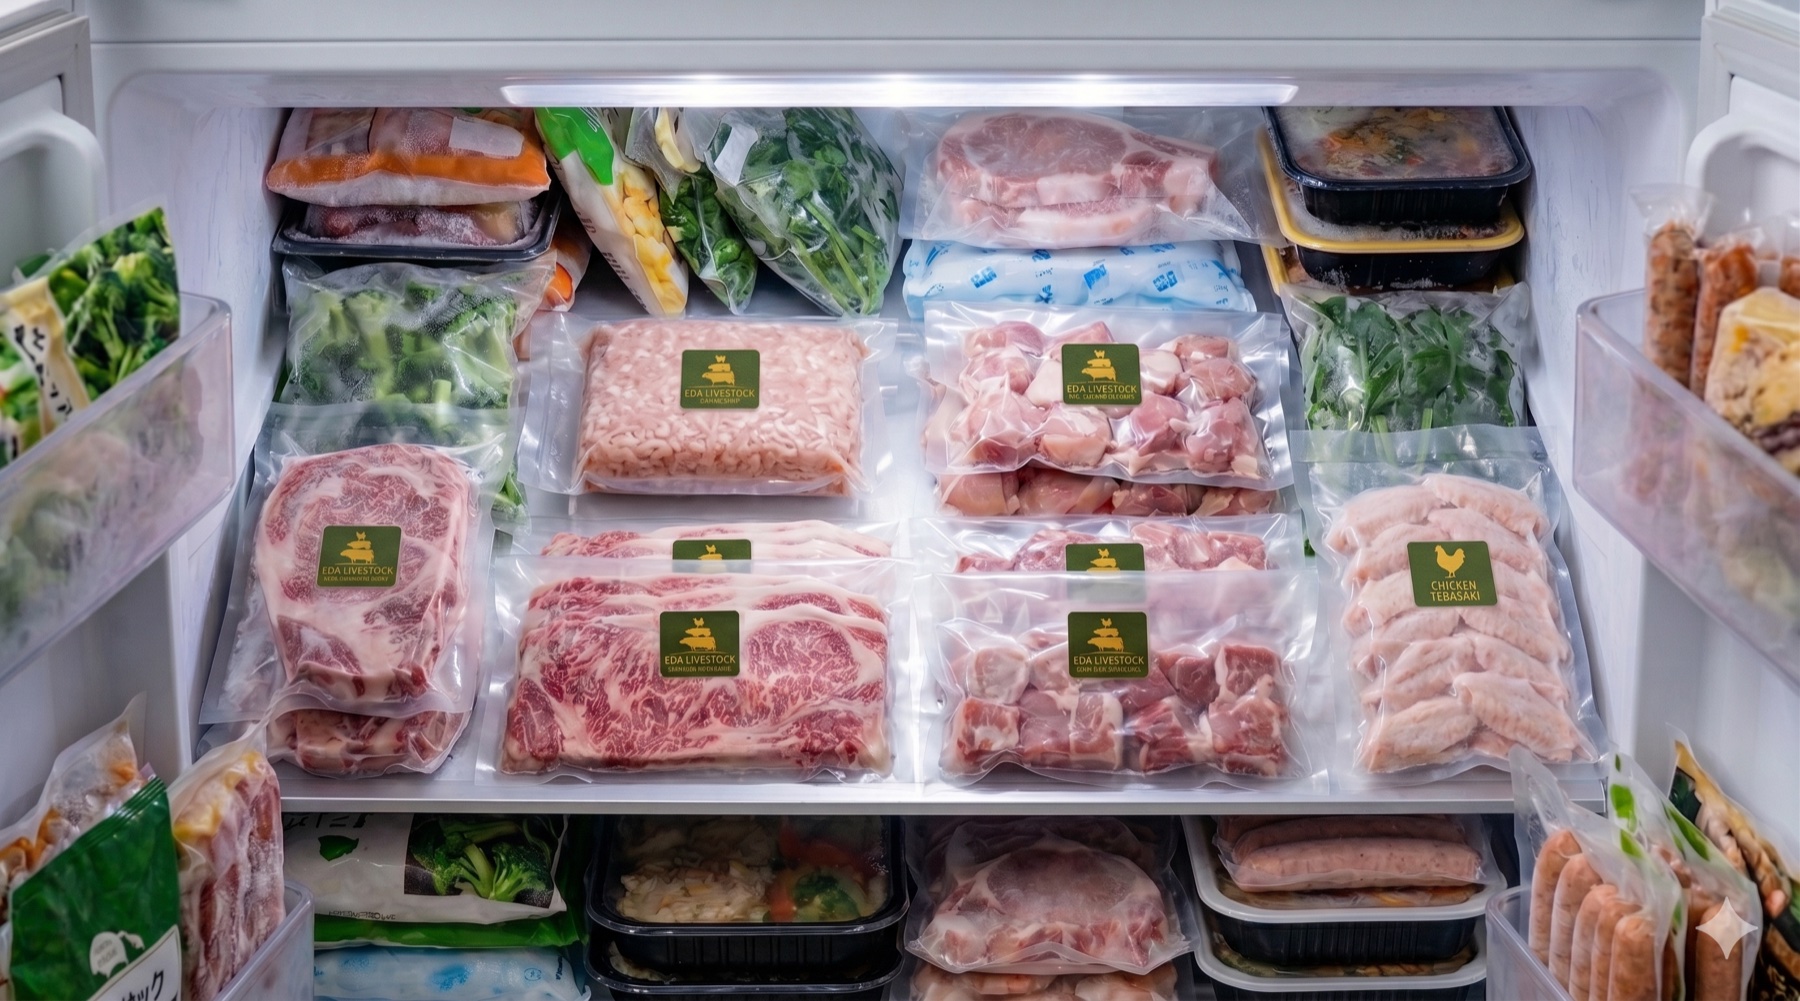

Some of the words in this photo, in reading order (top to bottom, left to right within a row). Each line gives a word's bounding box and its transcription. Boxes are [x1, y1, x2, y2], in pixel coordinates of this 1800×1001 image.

[684, 389, 703, 397] EDA
[705, 389, 755, 397] LIVESTOCK
[1067, 385, 1086, 393] EDA
[1088, 385, 1137, 393] LIVESTOCK
[322, 567, 341, 575] EDA
[343, 566, 394, 575] LIVESTOCK
[1431, 580, 1477, 591] CHICKEN
[1430, 591, 1480, 602] TEBASAKI
[664, 655, 684, 665] EDA
[686, 655, 736, 665] LIVESTOCK
[1073, 656, 1093, 665] EDA
[1094, 655, 1144, 665] LIVESTOCK
